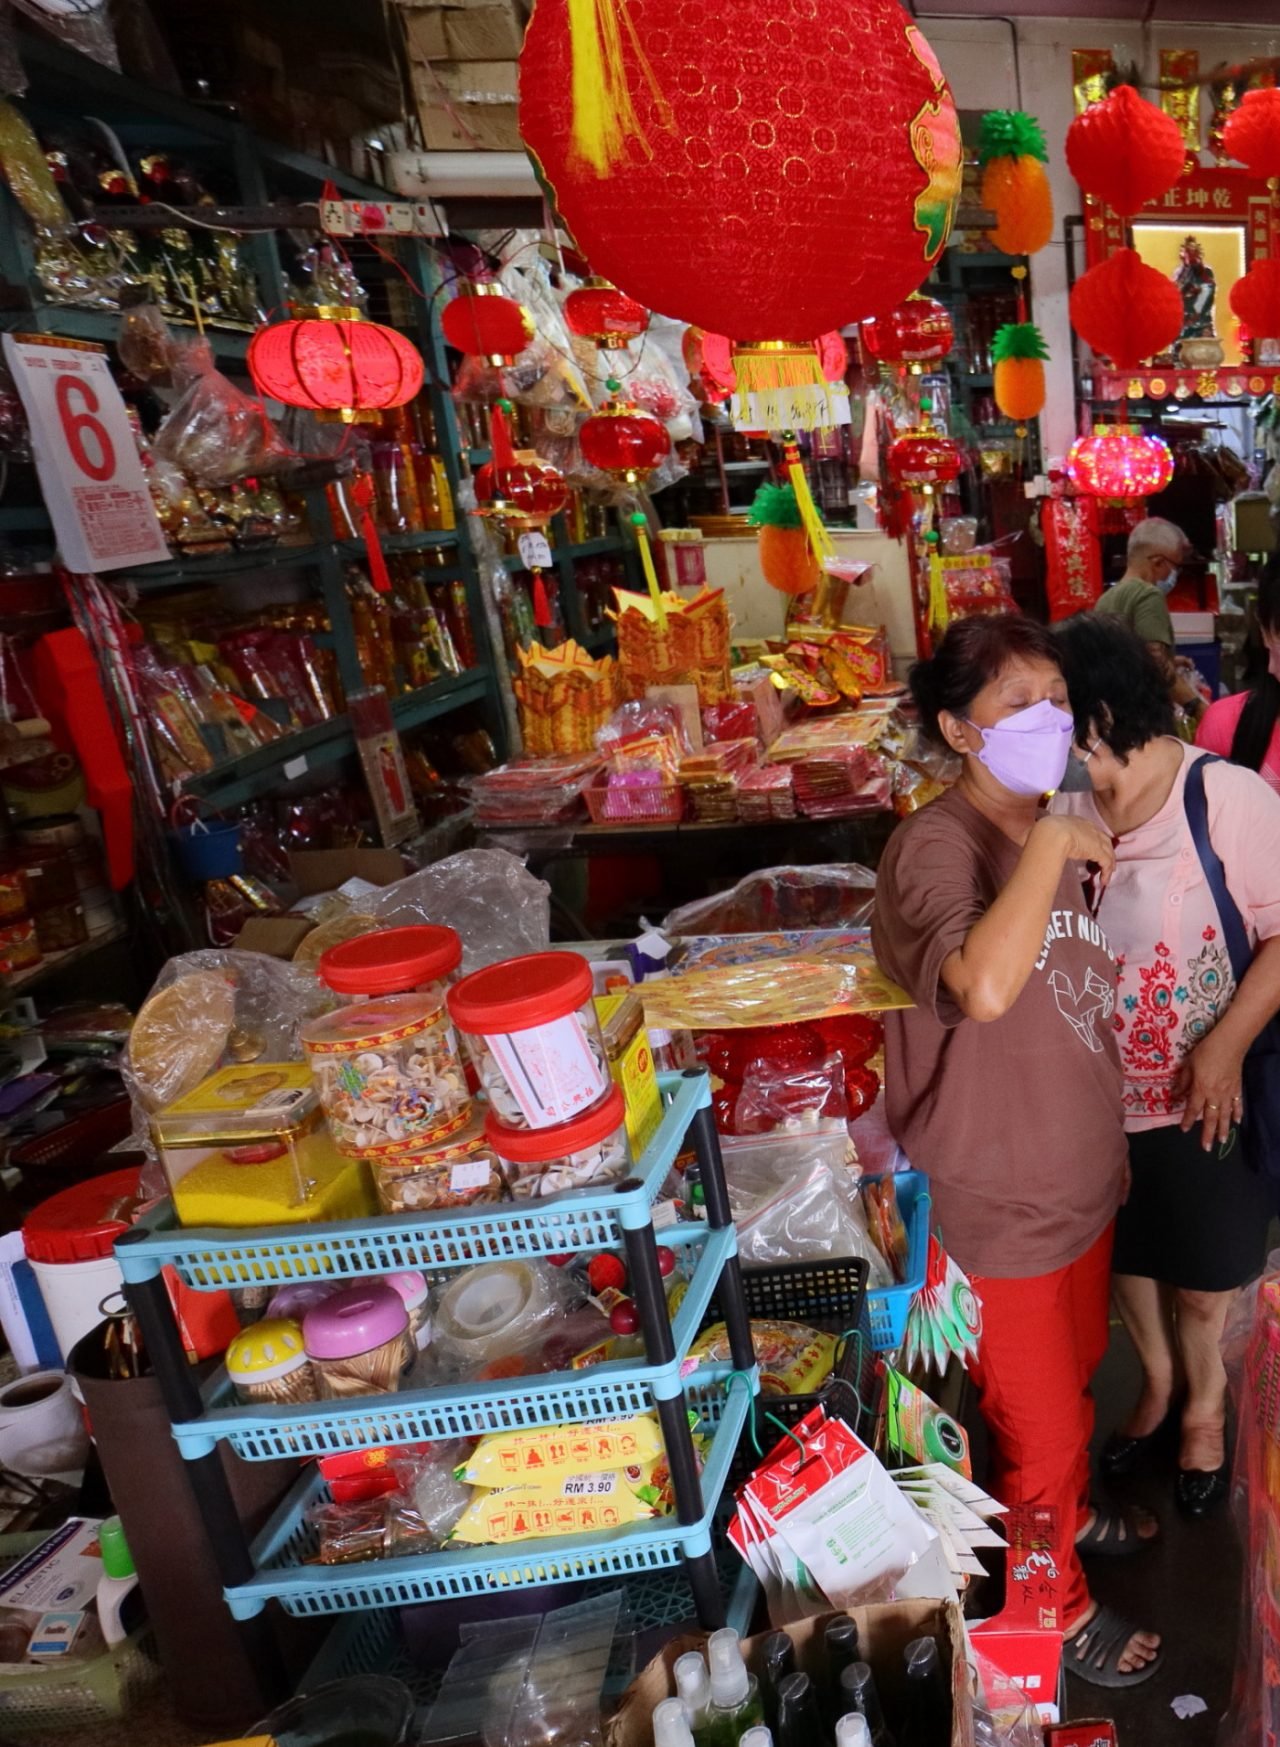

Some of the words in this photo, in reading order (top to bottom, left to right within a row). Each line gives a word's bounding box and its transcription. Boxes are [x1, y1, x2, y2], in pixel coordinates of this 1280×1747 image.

[1143, 187, 1232, 208] 乾坤正
[55, 374, 116, 481] 6
[565, 1483, 584, 1494] RM
[587, 1481, 612, 1493] 3.90
[9, 1558, 61, 1603] ELASTIC
[1043, 1607, 1057, 1628] 75
